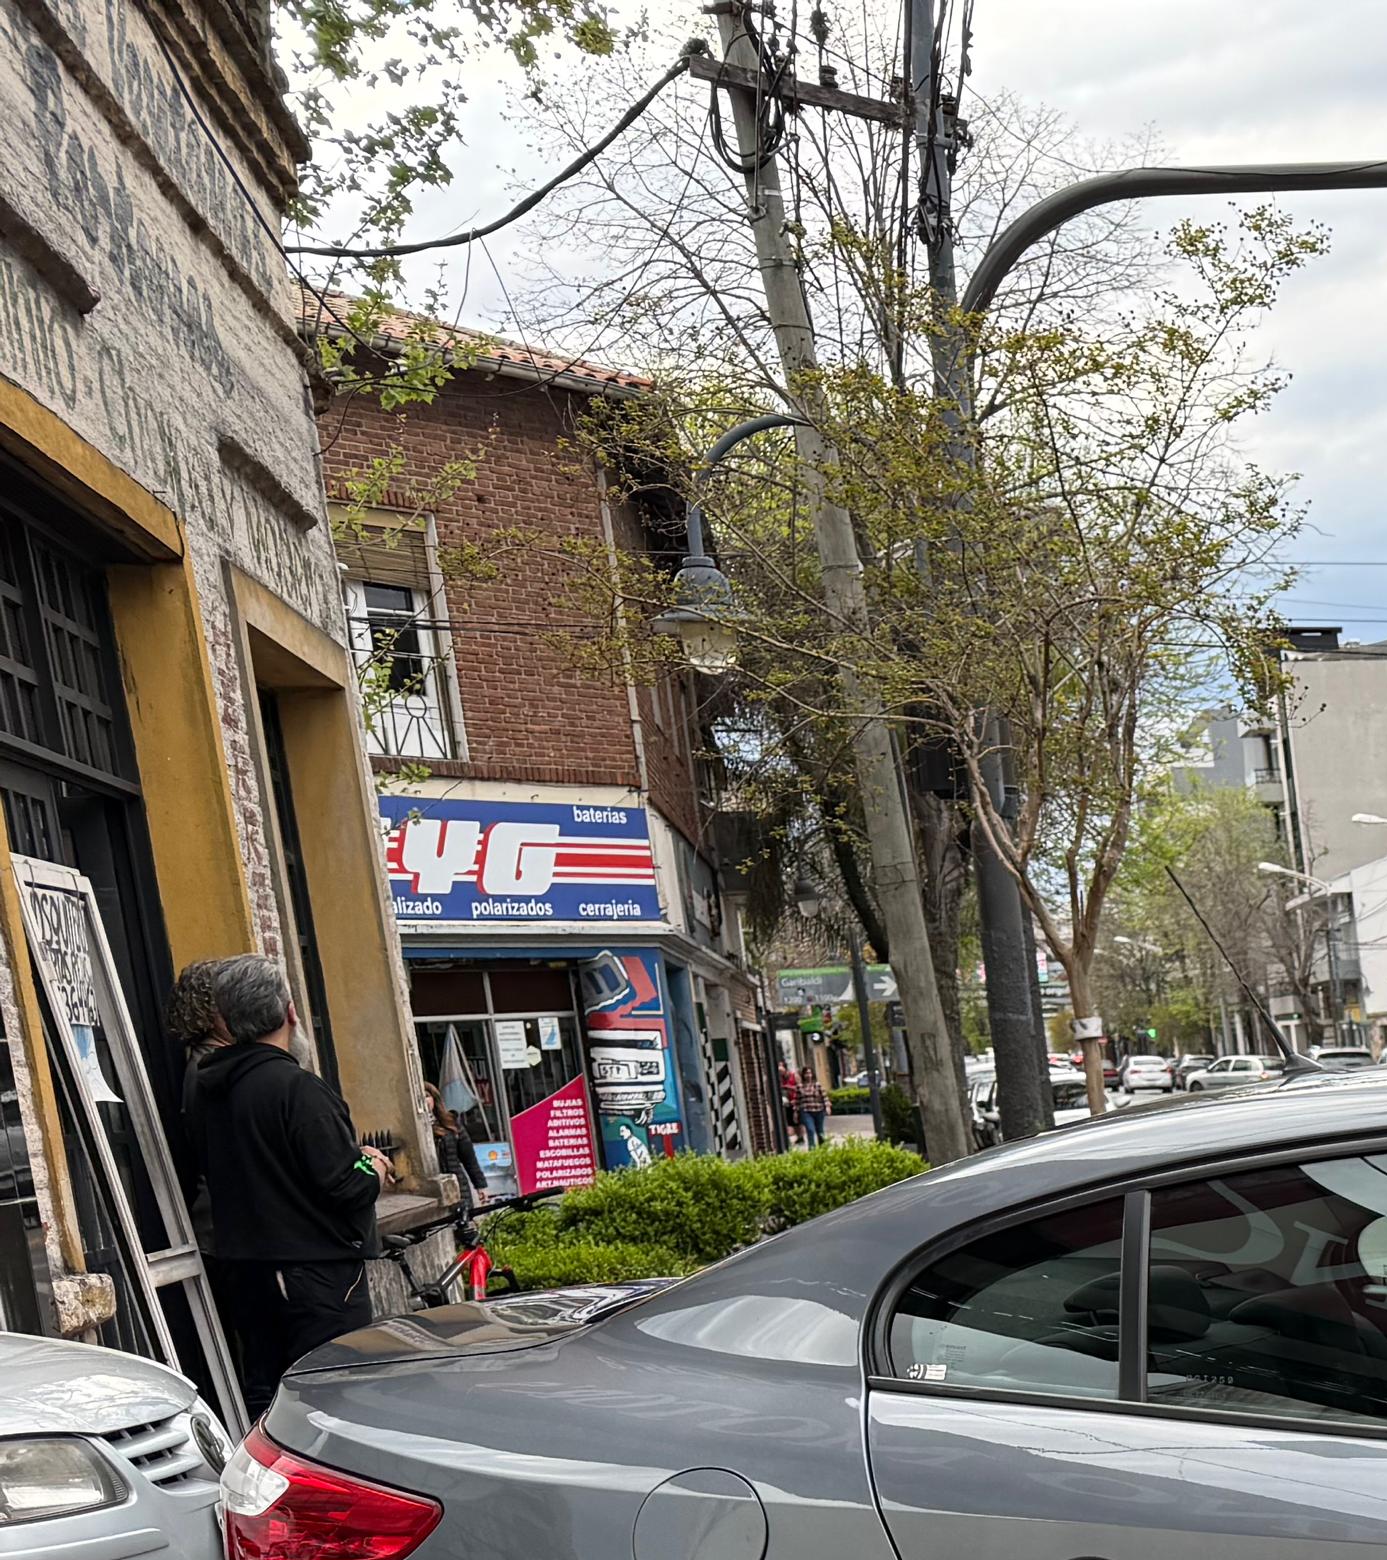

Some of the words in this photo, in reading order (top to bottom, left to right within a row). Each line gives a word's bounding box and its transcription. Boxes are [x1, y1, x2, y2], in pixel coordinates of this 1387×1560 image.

[572, 805, 628, 825] baterias
[380, 817, 560, 896] YG
[471, 898, 553, 918] polarizados
[578, 898, 641, 920] cerrajeria
[552, 1098, 583, 1108] BUJIAS
[550, 1108, 584, 1118] FILTROS
[547, 1117, 586, 1127] ADITIVOS
[547, 1127, 587, 1137] ALARMAS
[649, 1122, 679, 1135] TIGRE
[547, 1137, 588, 1147] BATERIAS
[539, 1147, 590, 1158] ESCOBILLAS
[535, 1157, 592, 1168] MATAFUEGOS
[535, 1167, 593, 1179] POLARIZADOS
